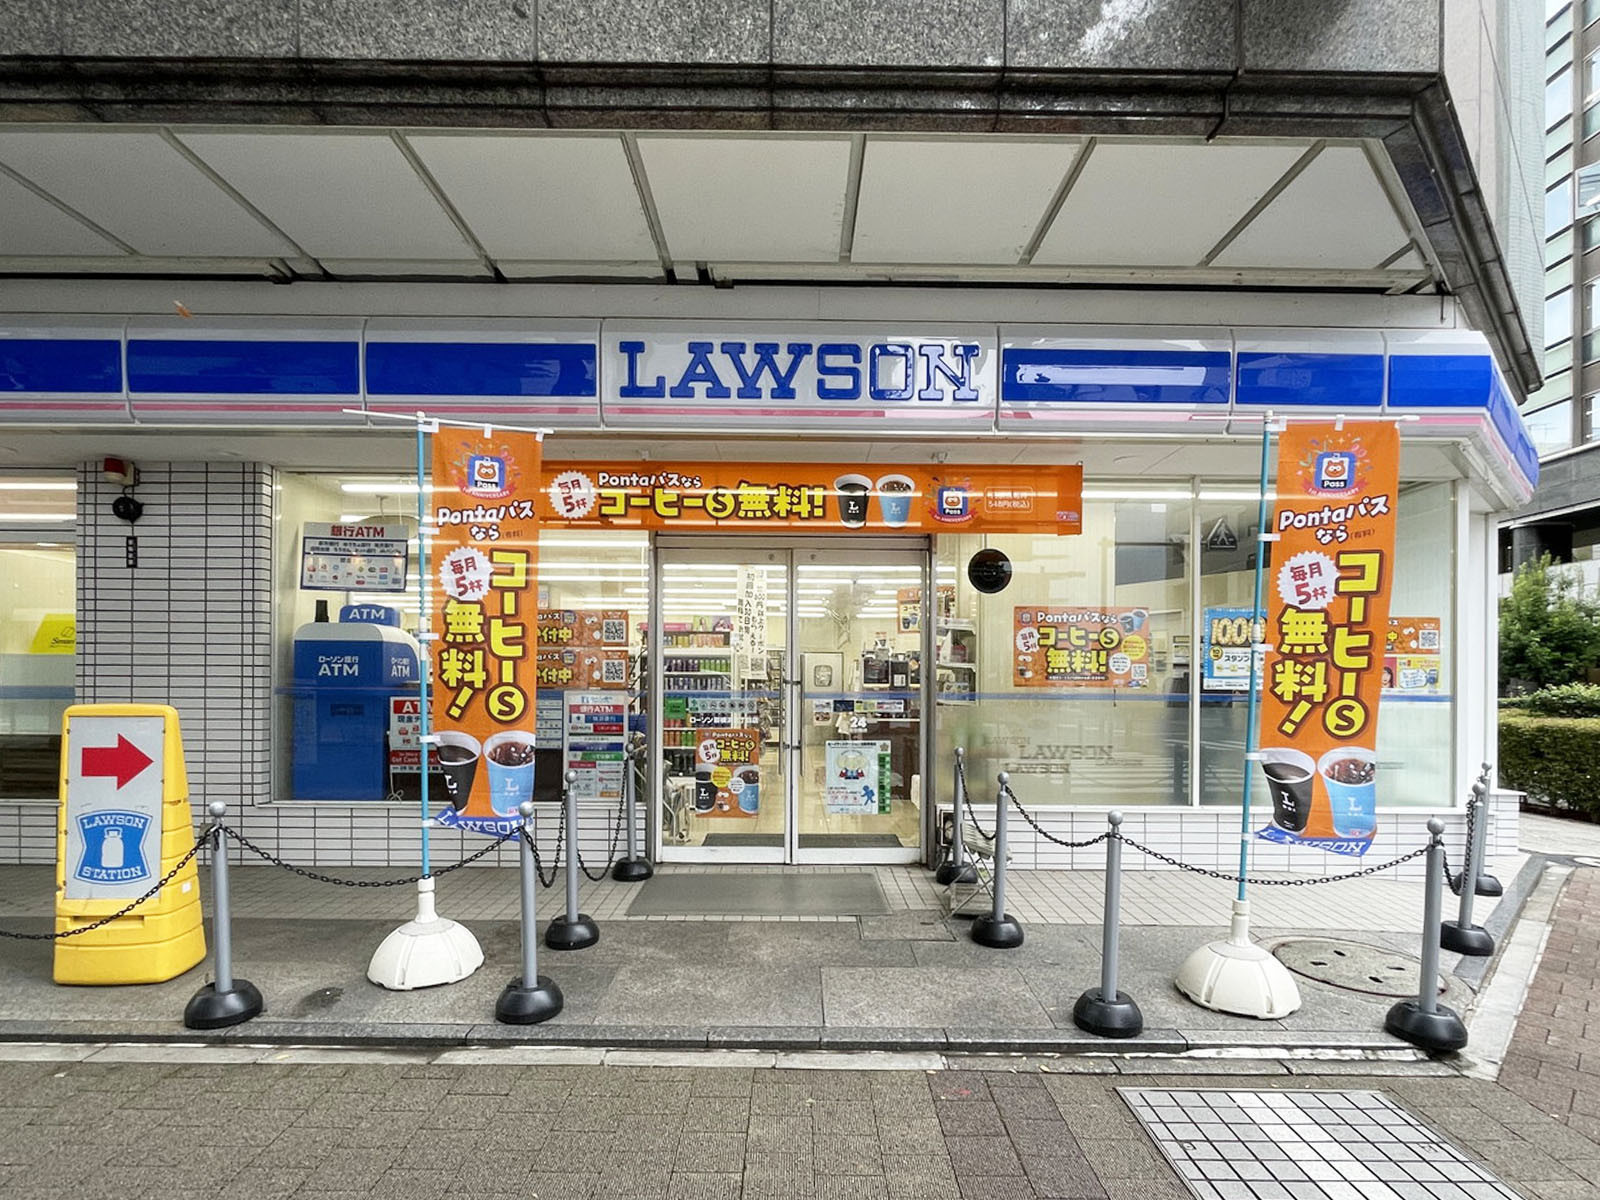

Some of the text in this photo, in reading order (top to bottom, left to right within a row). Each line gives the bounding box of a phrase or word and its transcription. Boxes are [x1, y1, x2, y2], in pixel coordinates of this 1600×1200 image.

[618, 341, 980, 400] LAWSON
[562, 495, 587, 513] 5杯
[437, 501, 534, 526] Pontaパス
[1279, 496, 1390, 531] Pontaパス
[470, 525, 499, 540] なら
[1315, 526, 1348, 544] なら
[450, 556, 477, 575] 毎月
[1290, 562, 1322, 582] 毎月
[455, 577, 484, 597] 5杯
[1295, 583, 1328, 605] 5杯
[349, 609, 385, 619] ATM
[1037, 611, 1118, 624] Pontaパスなら
[1047, 647, 1107, 673] 無料!
[318, 664, 359, 676] ATM
[391, 665, 410, 677] ATM
[850, 717, 867, 729] 24
[1018, 744, 1114, 760] LAWSON
[82, 815, 146, 829] LAWSON
[81, 866, 143, 880] STATION
